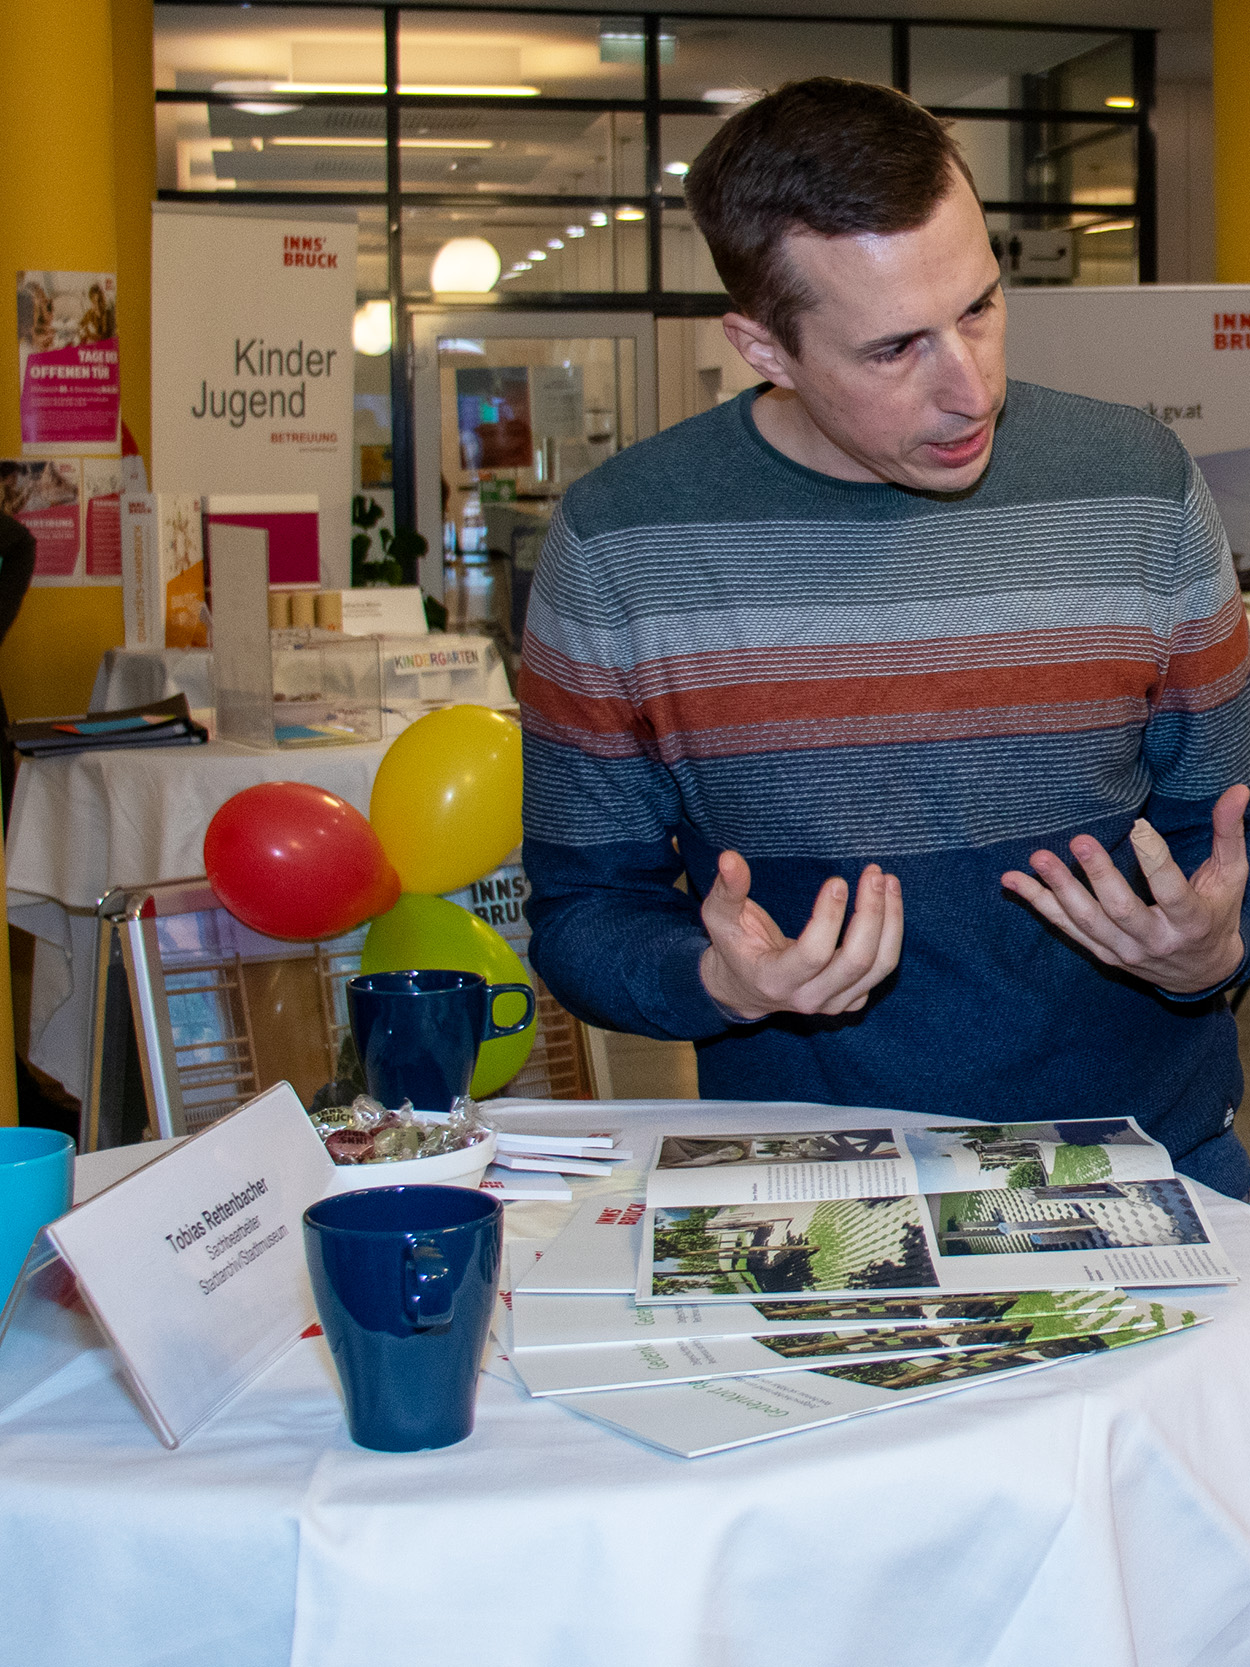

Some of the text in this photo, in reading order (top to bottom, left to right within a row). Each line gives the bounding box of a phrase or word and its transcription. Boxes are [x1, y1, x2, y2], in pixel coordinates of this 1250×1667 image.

[283, 252, 338, 268] BRUCK
[30, 366, 90, 379] OFFENEN
[234, 338, 337, 377] Kinder
[191, 380, 307, 428] Jugend
[271, 432, 338, 443] BETREUUNG
[395, 650, 479, 668] KINDERGARTEN
[165, 1178, 269, 1253] Tobias Rettenbacher
[205, 1215, 261, 1260] Sachbearbeiter
[199, 1224, 290, 1295] Stadtarchiv/Stadtmuseum
